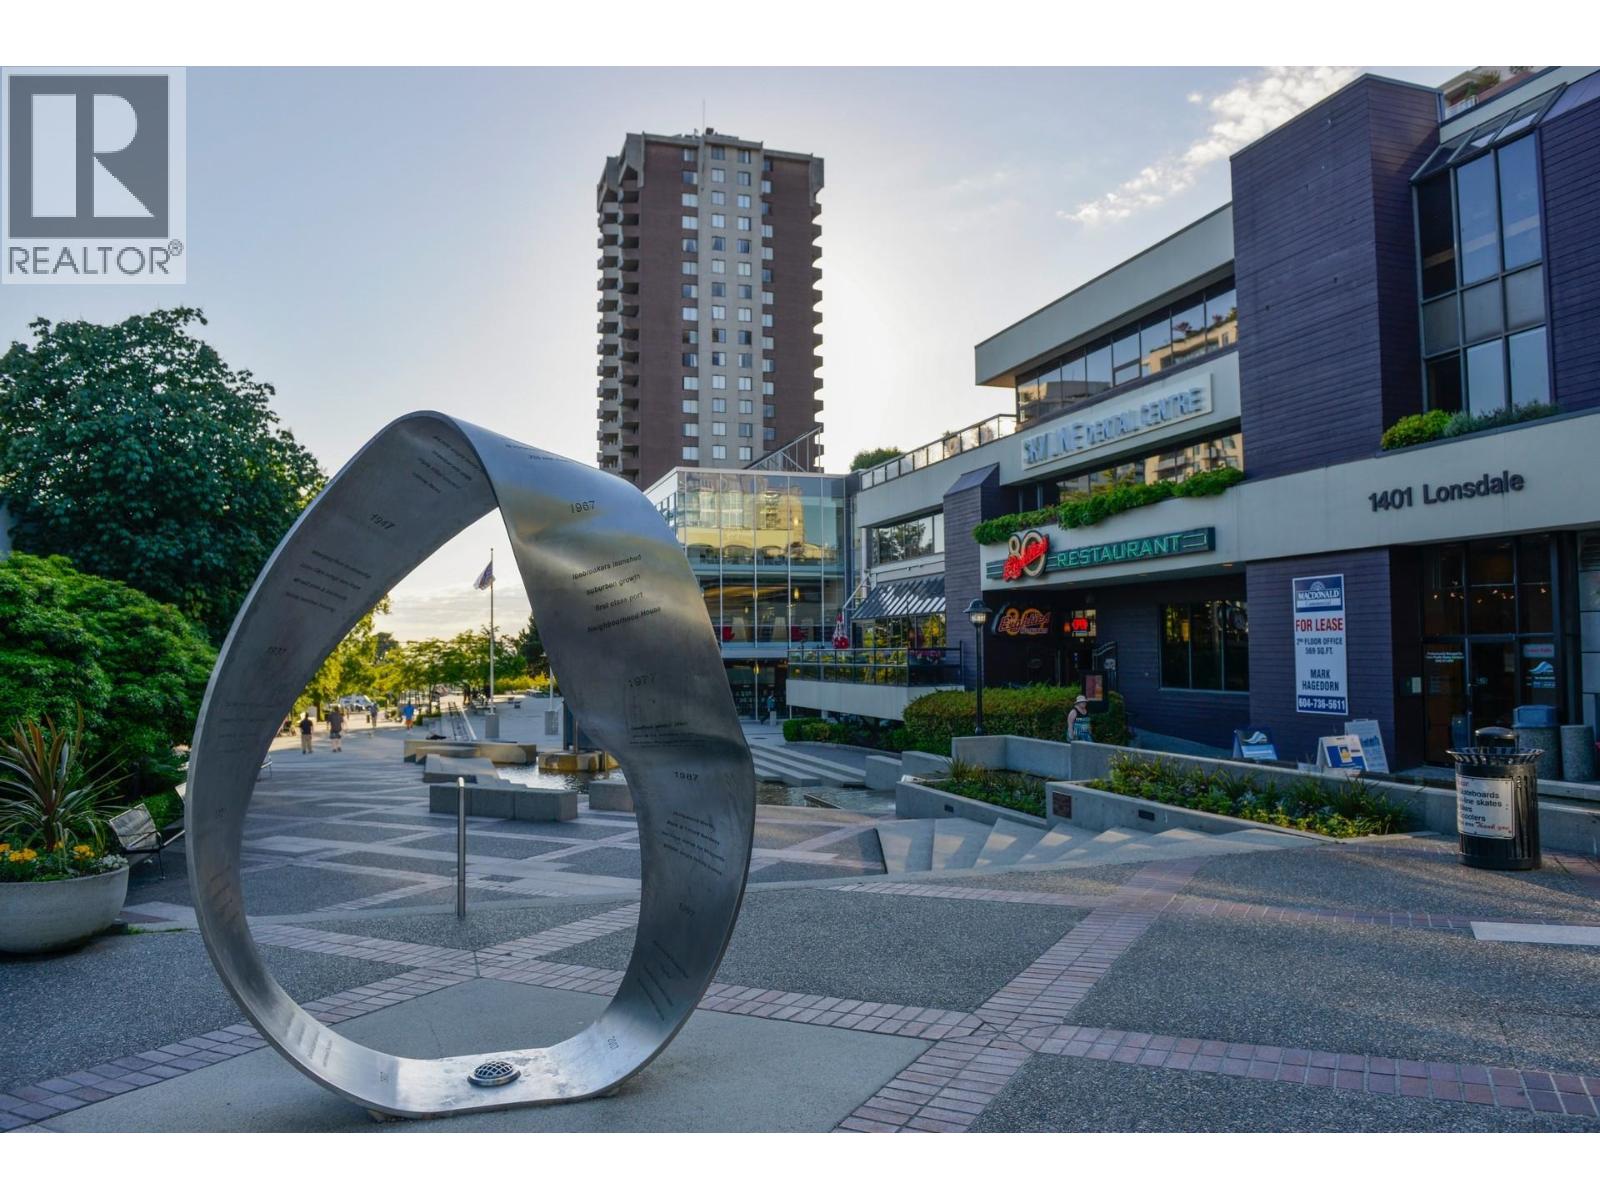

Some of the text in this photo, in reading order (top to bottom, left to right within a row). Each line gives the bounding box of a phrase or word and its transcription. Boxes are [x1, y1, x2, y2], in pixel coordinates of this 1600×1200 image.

[1085, 409, 1140, 445] DENTAL
[1140, 387, 1203, 427] CENTRE
[1368, 470, 1525, 512] 1401 Lonsdale
[571, 500, 595, 513] 1967
[1056, 534, 1183, 567] RESTAURANT
[618, 573, 641, 587] growth
[629, 591, 644, 603] port
[1298, 590, 1340, 600] MACDONALD
[1296, 617, 1344, 632] FOR LEASE
[1304, 637, 1322, 646] FLOOR
[1322, 636, 1343, 645] OFFICE
[1310, 669, 1331, 679] MARK
[1302, 681, 1340, 691] HAGEDORN
[1476, 799, 1503, 807] skates
